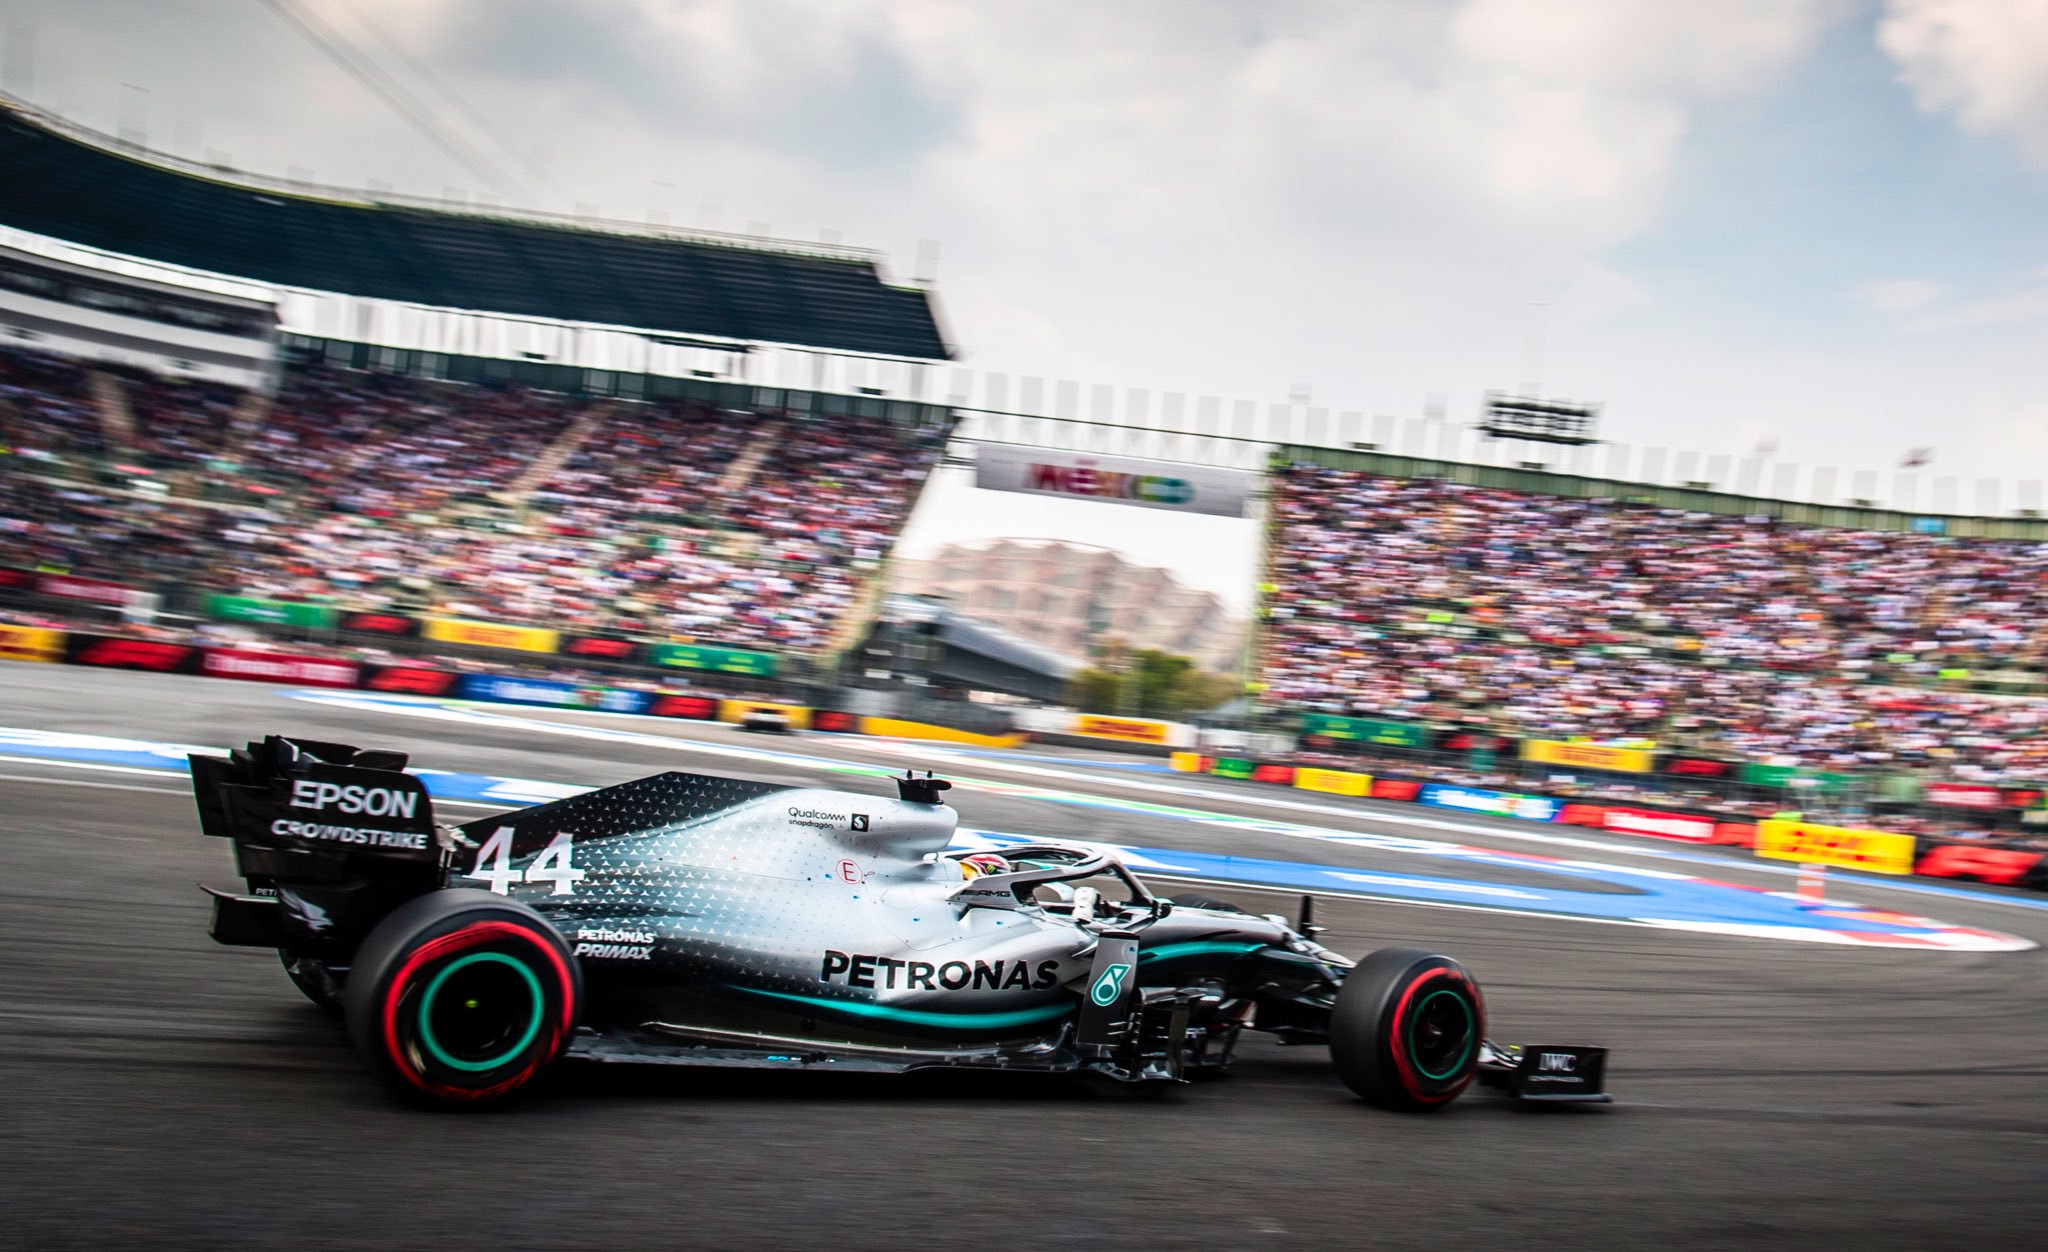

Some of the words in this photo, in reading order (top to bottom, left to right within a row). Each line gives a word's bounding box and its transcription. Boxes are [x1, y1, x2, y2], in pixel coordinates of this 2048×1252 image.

[289, 779, 418, 819] EPSON
[788, 806, 846, 822] Qualcomm
[271, 819, 428, 849] CROWDSTRIKE
[788, 819, 834, 830] snapdragon
[462, 826, 585, 896] 44
[842, 862, 857, 882] E
[577, 929, 655, 944] PETRONAS
[573, 943, 656, 960] PRIMAX
[822, 950, 1059, 991] PETRONAS
[1538, 1053, 1577, 1071] IWC
